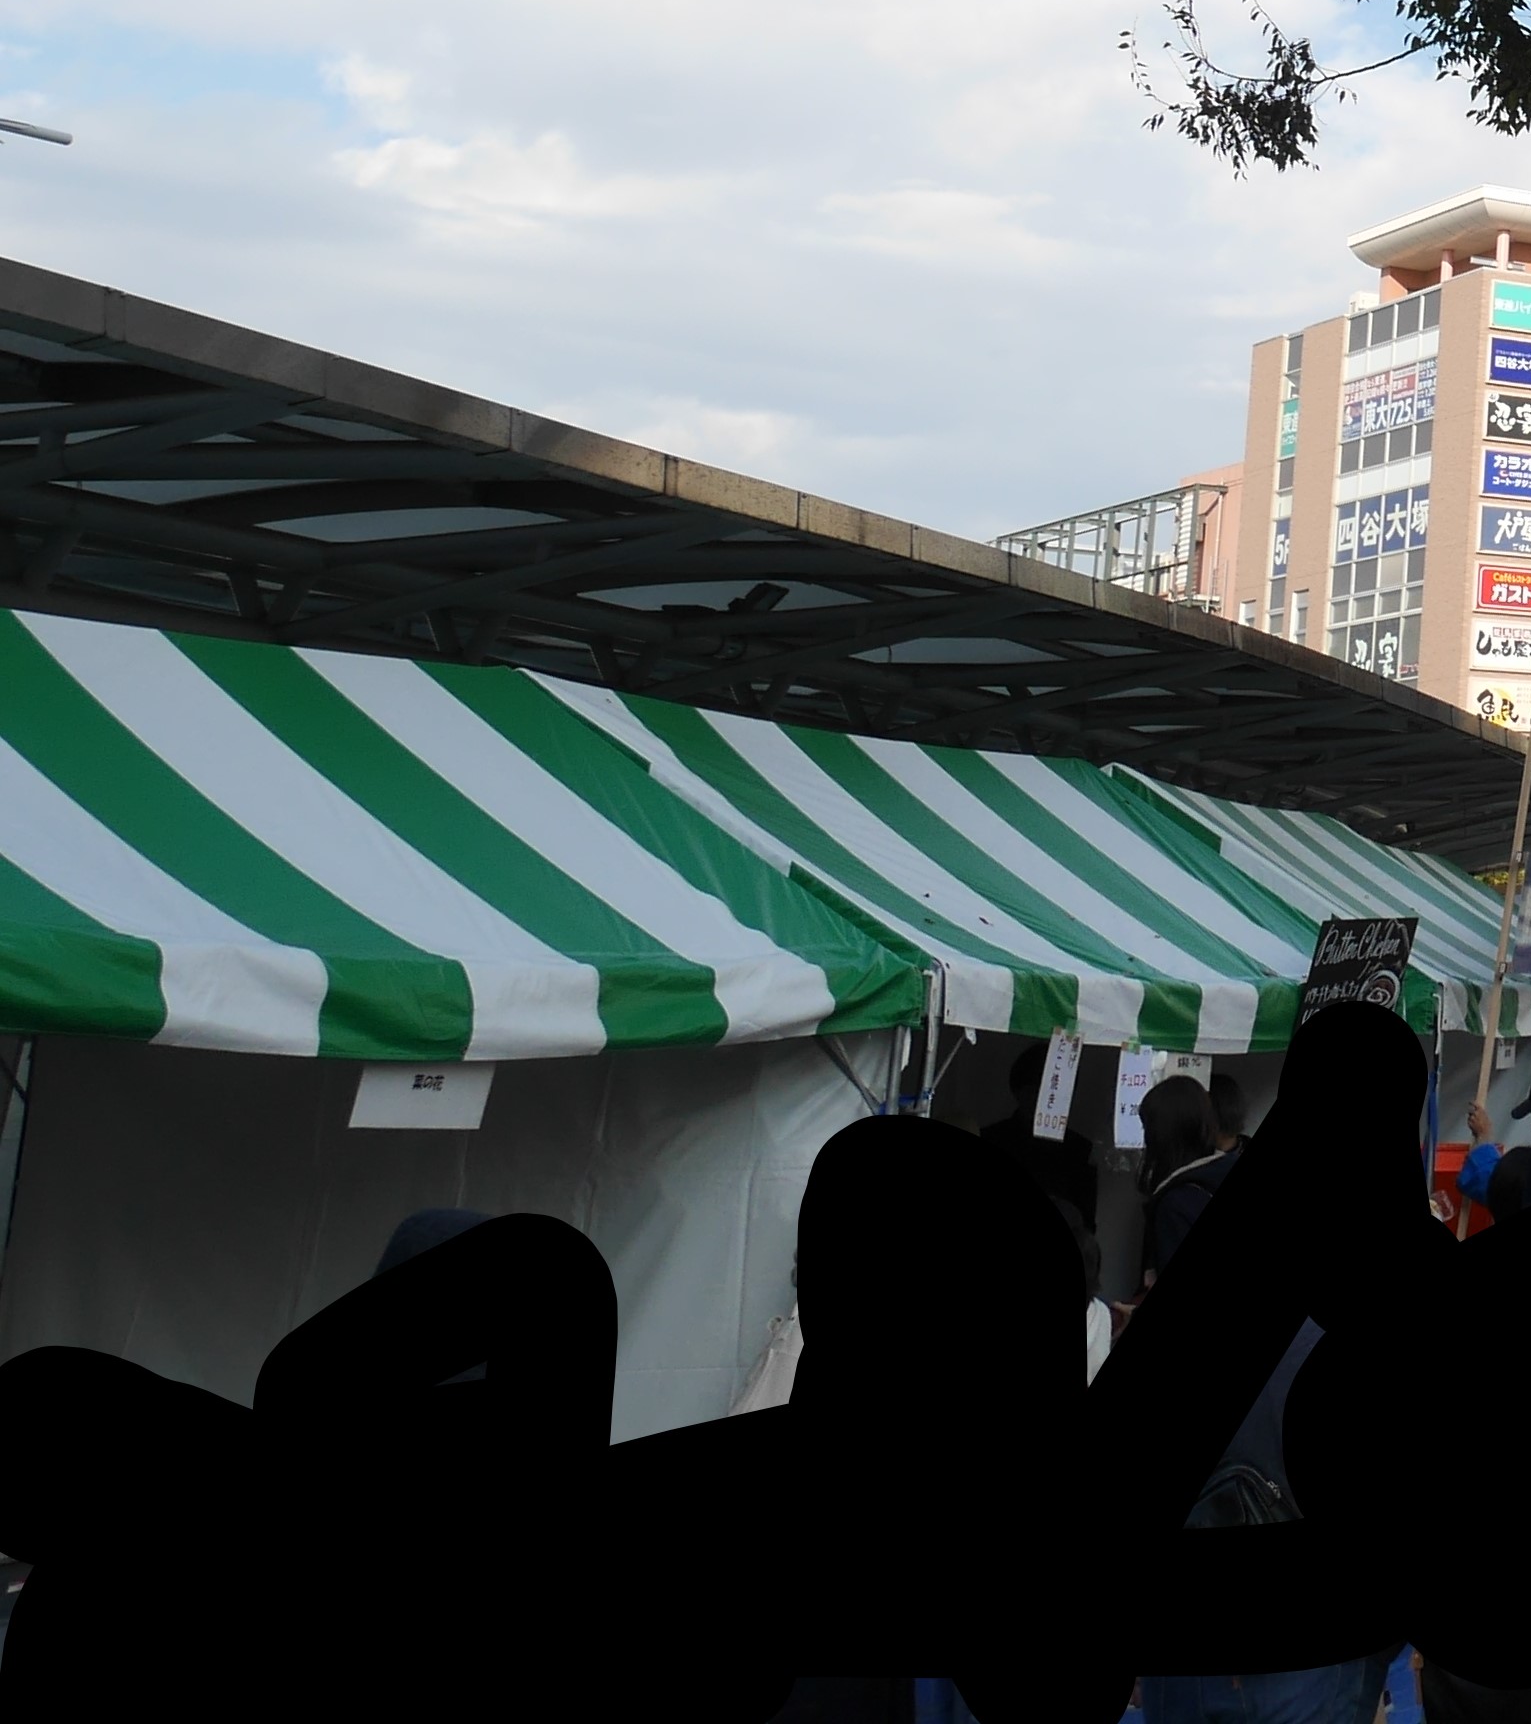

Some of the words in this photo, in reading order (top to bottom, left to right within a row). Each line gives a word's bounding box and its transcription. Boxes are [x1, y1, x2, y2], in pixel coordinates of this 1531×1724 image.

[1364, 397, 1414, 432] 東大725
[1337, 499, 1430, 553] 四谷大塚
[1476, 688, 1519, 723] 魚民
[1120, 1073, 1147, 1087] チュロス
